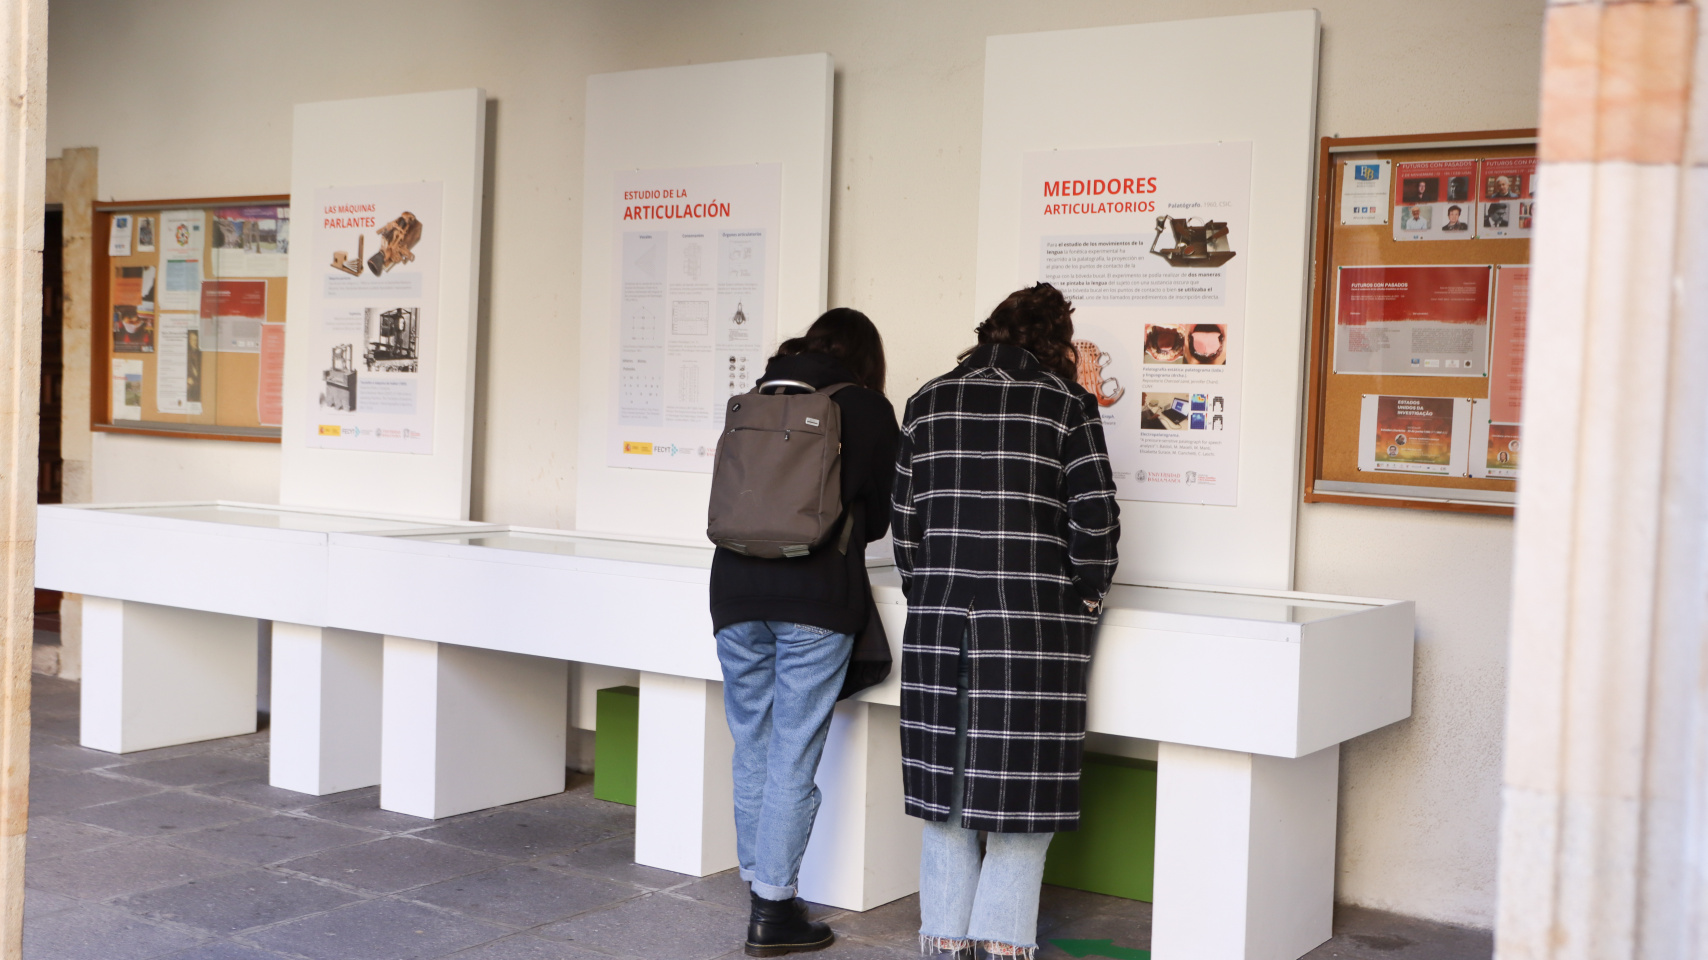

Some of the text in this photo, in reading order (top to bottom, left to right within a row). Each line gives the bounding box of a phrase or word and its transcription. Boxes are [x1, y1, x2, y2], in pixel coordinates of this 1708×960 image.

[1044, 177, 1157, 197] MEDIDORES
[624, 189, 687, 200] ESTUDIO DE LA
[324, 203, 376, 215] LAS MÁQUINAS
[624, 199, 730, 220] ARTICULACIÓN
[1044, 201, 1155, 215] ARTICULATORIOS
[324, 217, 375, 229] PARLANTES
